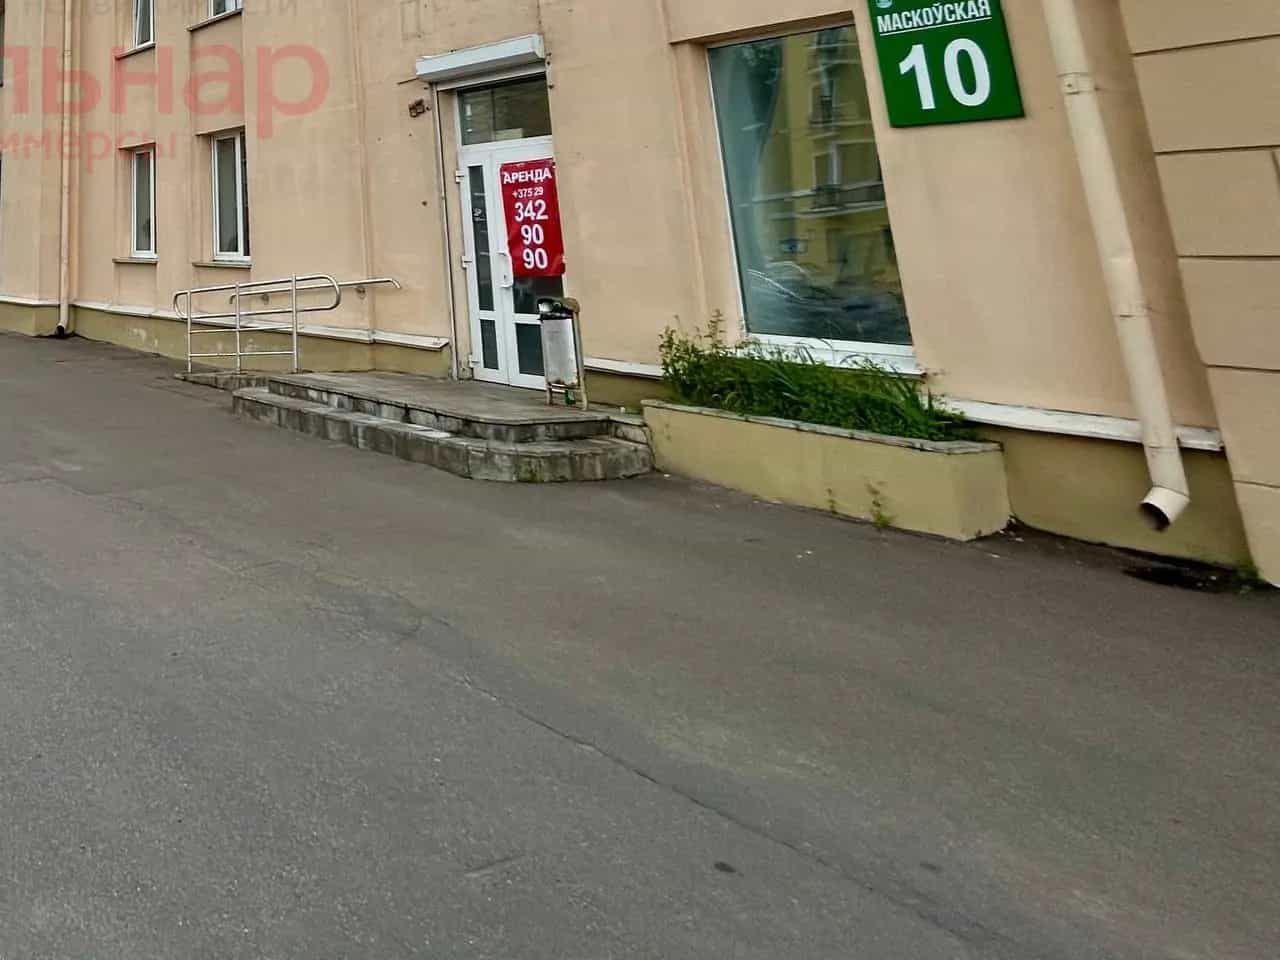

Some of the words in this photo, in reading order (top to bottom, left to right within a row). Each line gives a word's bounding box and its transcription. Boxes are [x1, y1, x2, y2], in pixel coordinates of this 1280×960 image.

[898, 38, 991, 110] 10
[503, 167, 553, 185] АРЕНДА
[512, 188, 532, 199] +375
[533, 186, 544, 197] 29
[514, 199, 548, 222] 342
[521, 223, 544, 245] 90
[522, 248, 548, 269] 90
